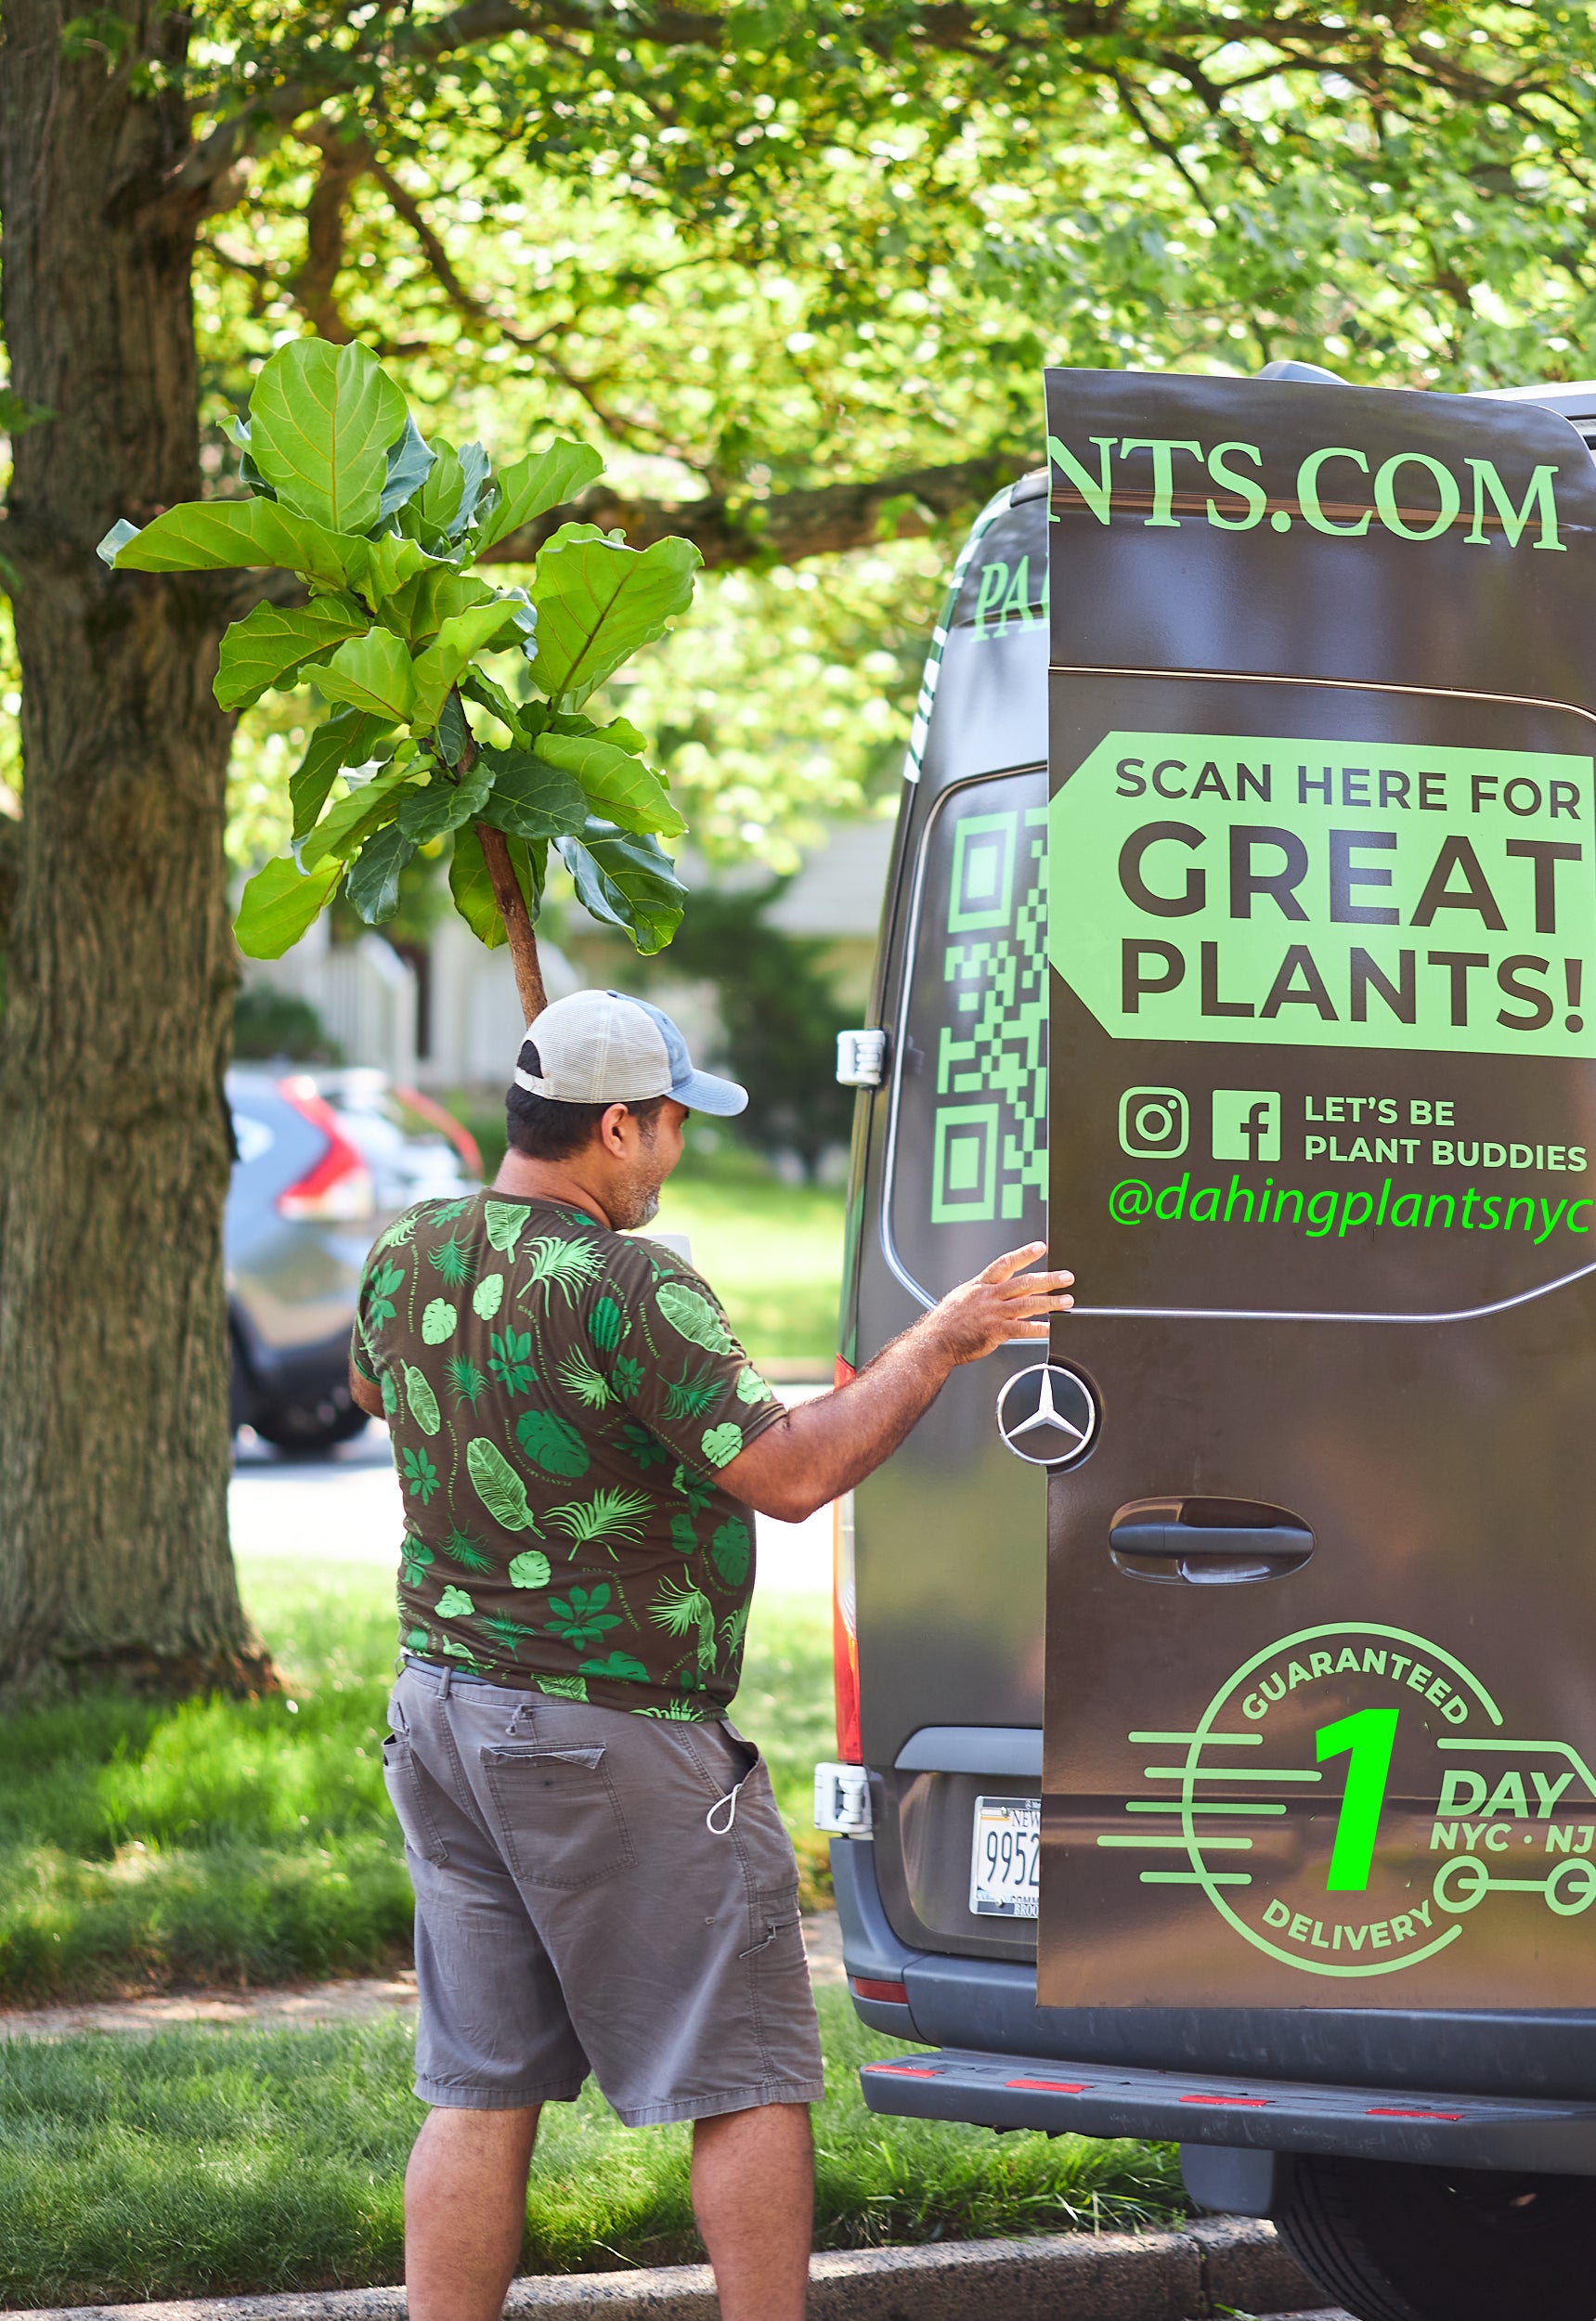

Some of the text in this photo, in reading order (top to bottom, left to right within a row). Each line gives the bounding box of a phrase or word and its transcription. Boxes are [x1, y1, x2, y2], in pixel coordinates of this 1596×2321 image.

[1048, 435, 1567, 551] NTS.COM
[969, 552, 1049, 643] PA
[1115, 758, 1581, 820] SCAN HERE FOR
[1118, 821, 1583, 935] GREAT
[1121, 938, 1584, 1033] PLANTS!
[1304, 1096, 1455, 1126] LET'S BE
[1304, 1135, 1588, 1172] PLANT BUDDIES
[1109, 1173, 1594, 1245] @dahingplantsnyc
[1240, 1646, 1470, 1725] GUARANTEED
[1314, 1708, 1577, 1891] 1 DAY
[987, 1830, 1039, 1887] 9952
[1430, 1822, 1596, 1854] NYC NJ
[1261, 1900, 1434, 1951] DELIVERY
